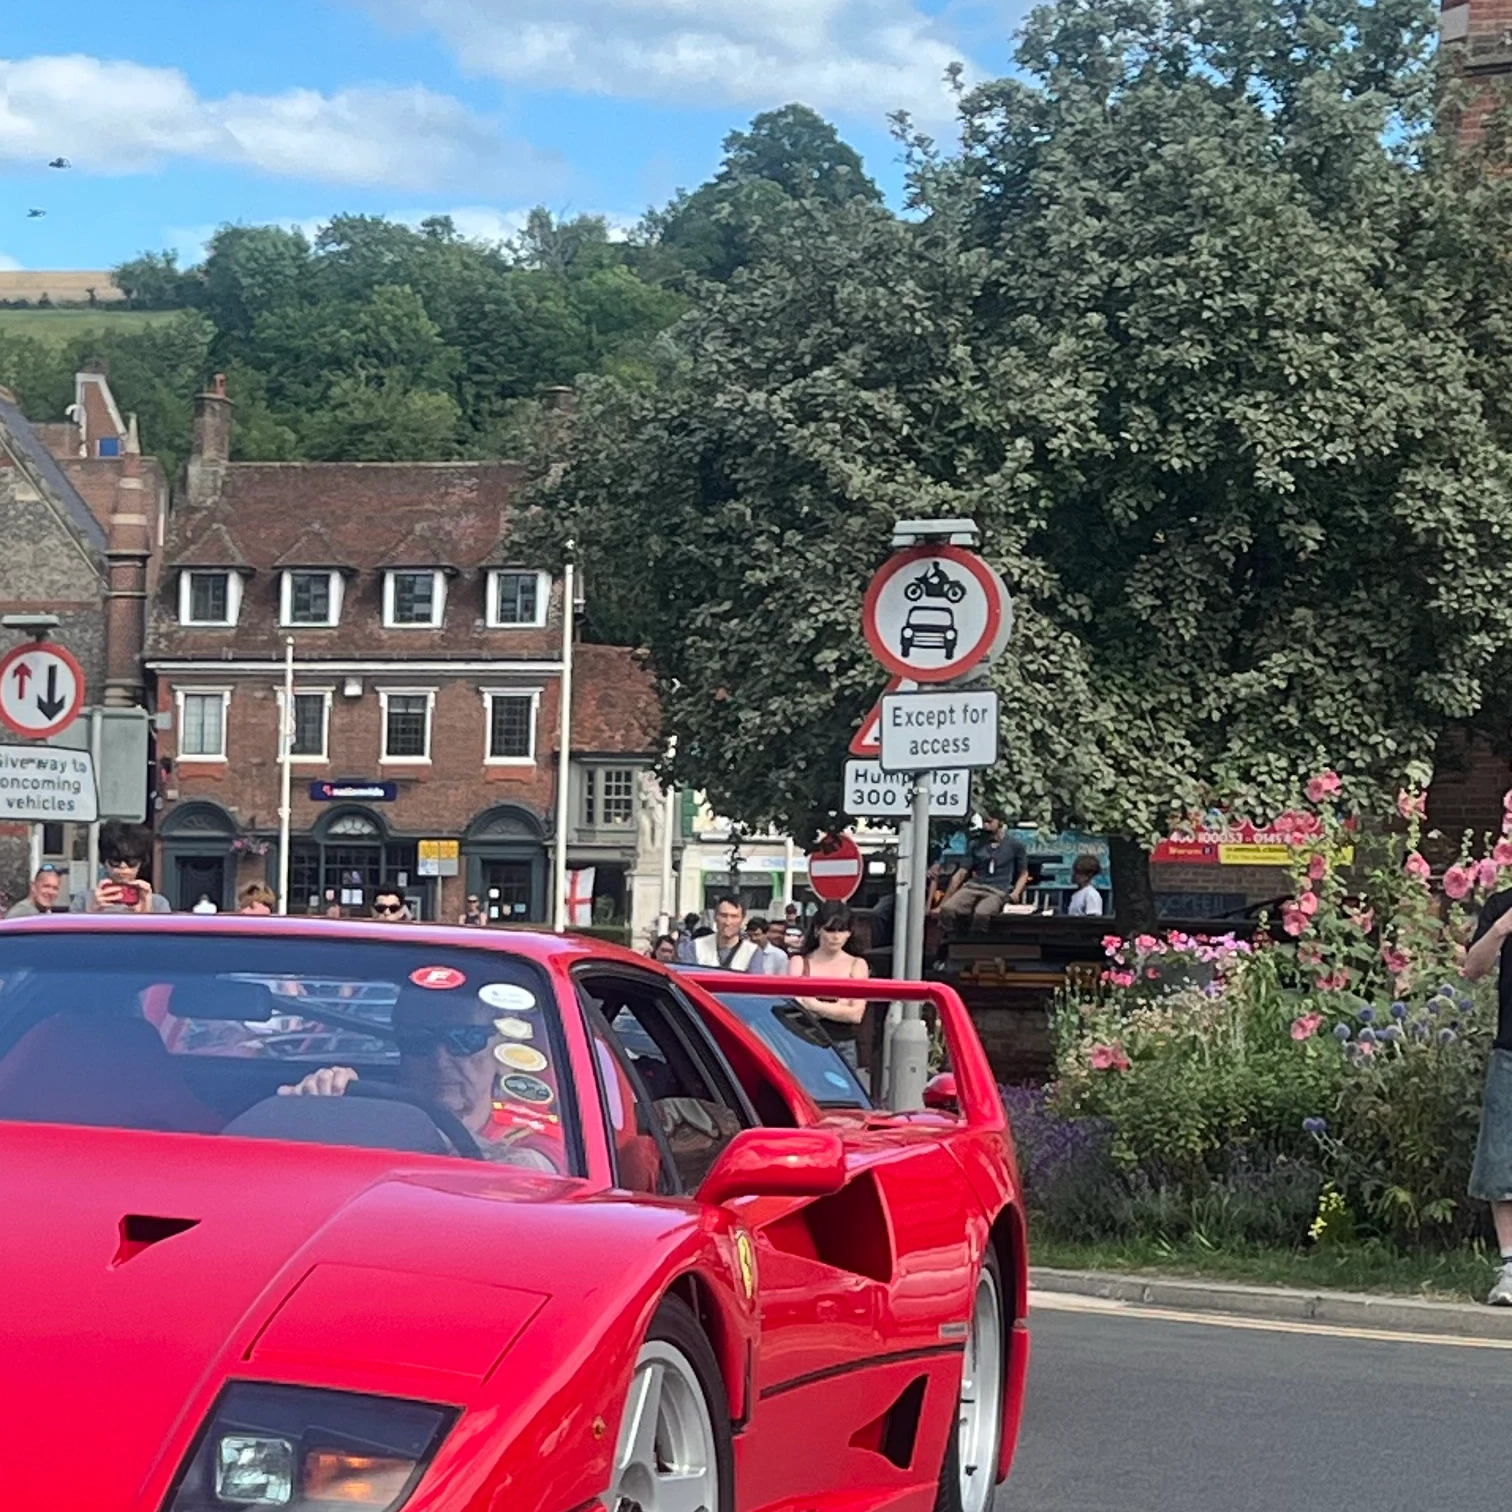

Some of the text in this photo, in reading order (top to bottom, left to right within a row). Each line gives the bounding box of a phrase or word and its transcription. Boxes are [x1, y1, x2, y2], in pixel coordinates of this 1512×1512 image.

[892, 704, 988, 729] Except for
[909, 736, 971, 756] access
[72, 758, 88, 774] to
[0, 775, 82, 795] oncoming
[6, 795, 76, 812] vehicles
[852, 789, 897, 806] 300
